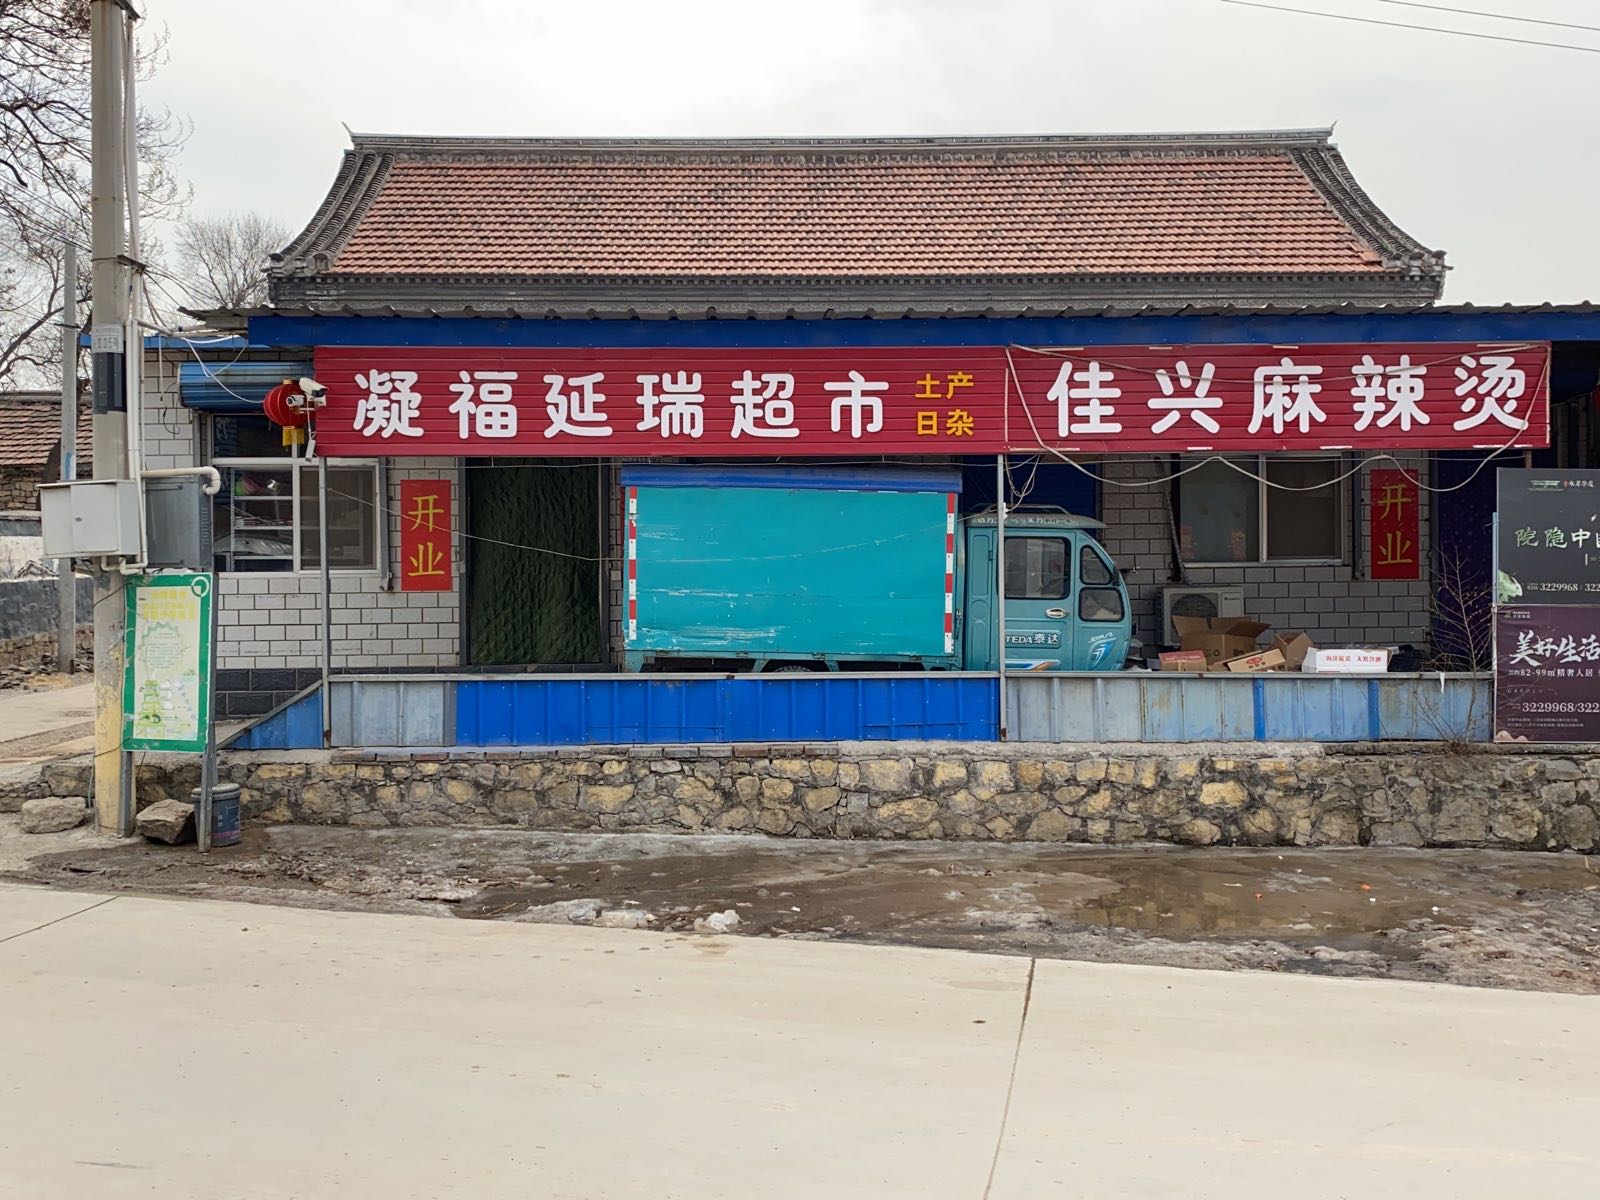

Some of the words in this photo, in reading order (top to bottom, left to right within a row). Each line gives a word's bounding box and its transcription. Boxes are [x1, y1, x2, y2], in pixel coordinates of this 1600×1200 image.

[353, 369, 890, 439] 凝福延瑞超市
[915, 372, 974, 400] 土产
[1046, 354, 1529, 438] 佳兴麻辣烫
[916, 408, 974, 436] 日杂
[408, 495, 445, 576] 开业
[1377, 484, 1412, 565] 开业
[1515, 527, 1600, 549] 院隐中
[1508, 629, 1600, 667] 美好生活
